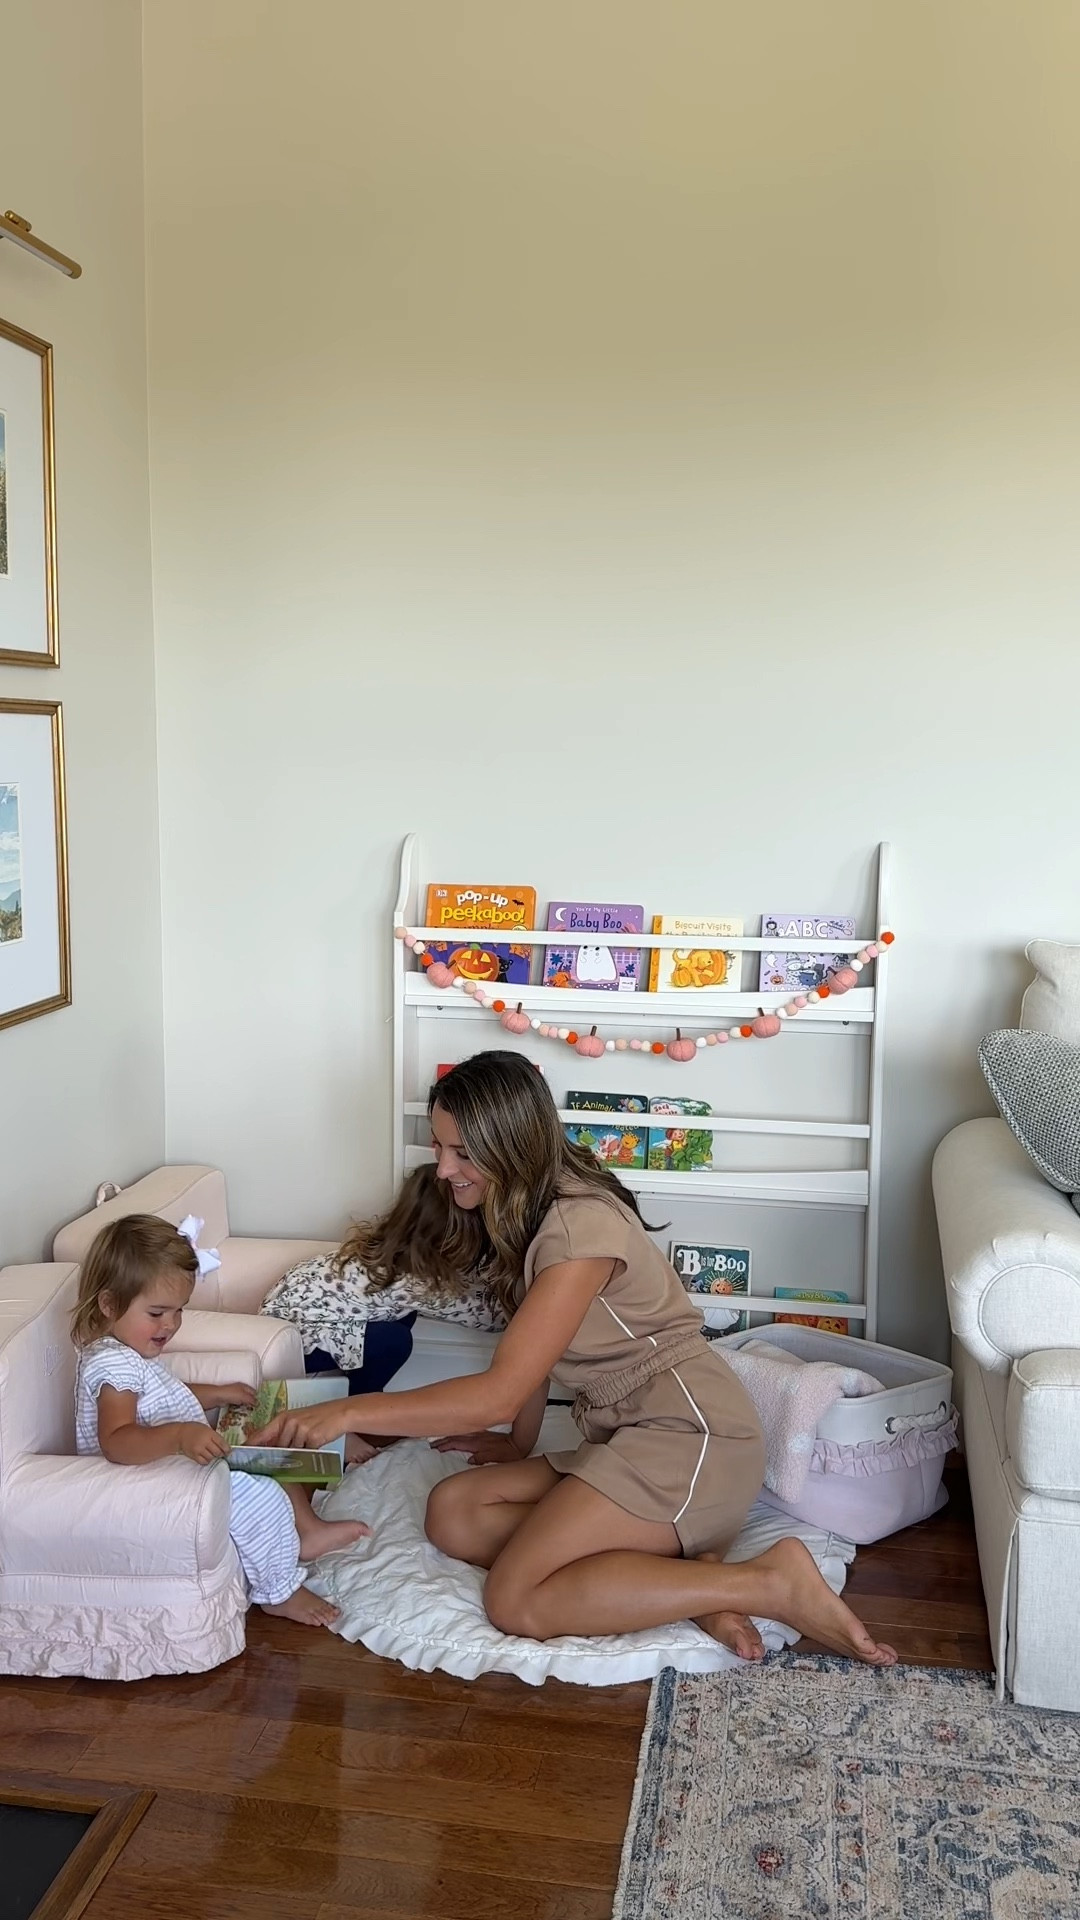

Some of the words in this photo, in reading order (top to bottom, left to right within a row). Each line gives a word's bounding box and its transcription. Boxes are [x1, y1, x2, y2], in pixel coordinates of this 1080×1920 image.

[456, 890, 509, 907] pop-up
[440, 905, 525, 923] peekaboo!
[570, 912, 599, 932] Baby
[603, 912, 622, 928] Boo
[675, 920, 705, 930] Biscuit
[706, 922, 732, 931] Visits
[676, 1248, 702, 1275] B
[714, 1254, 747, 1272] Boo
